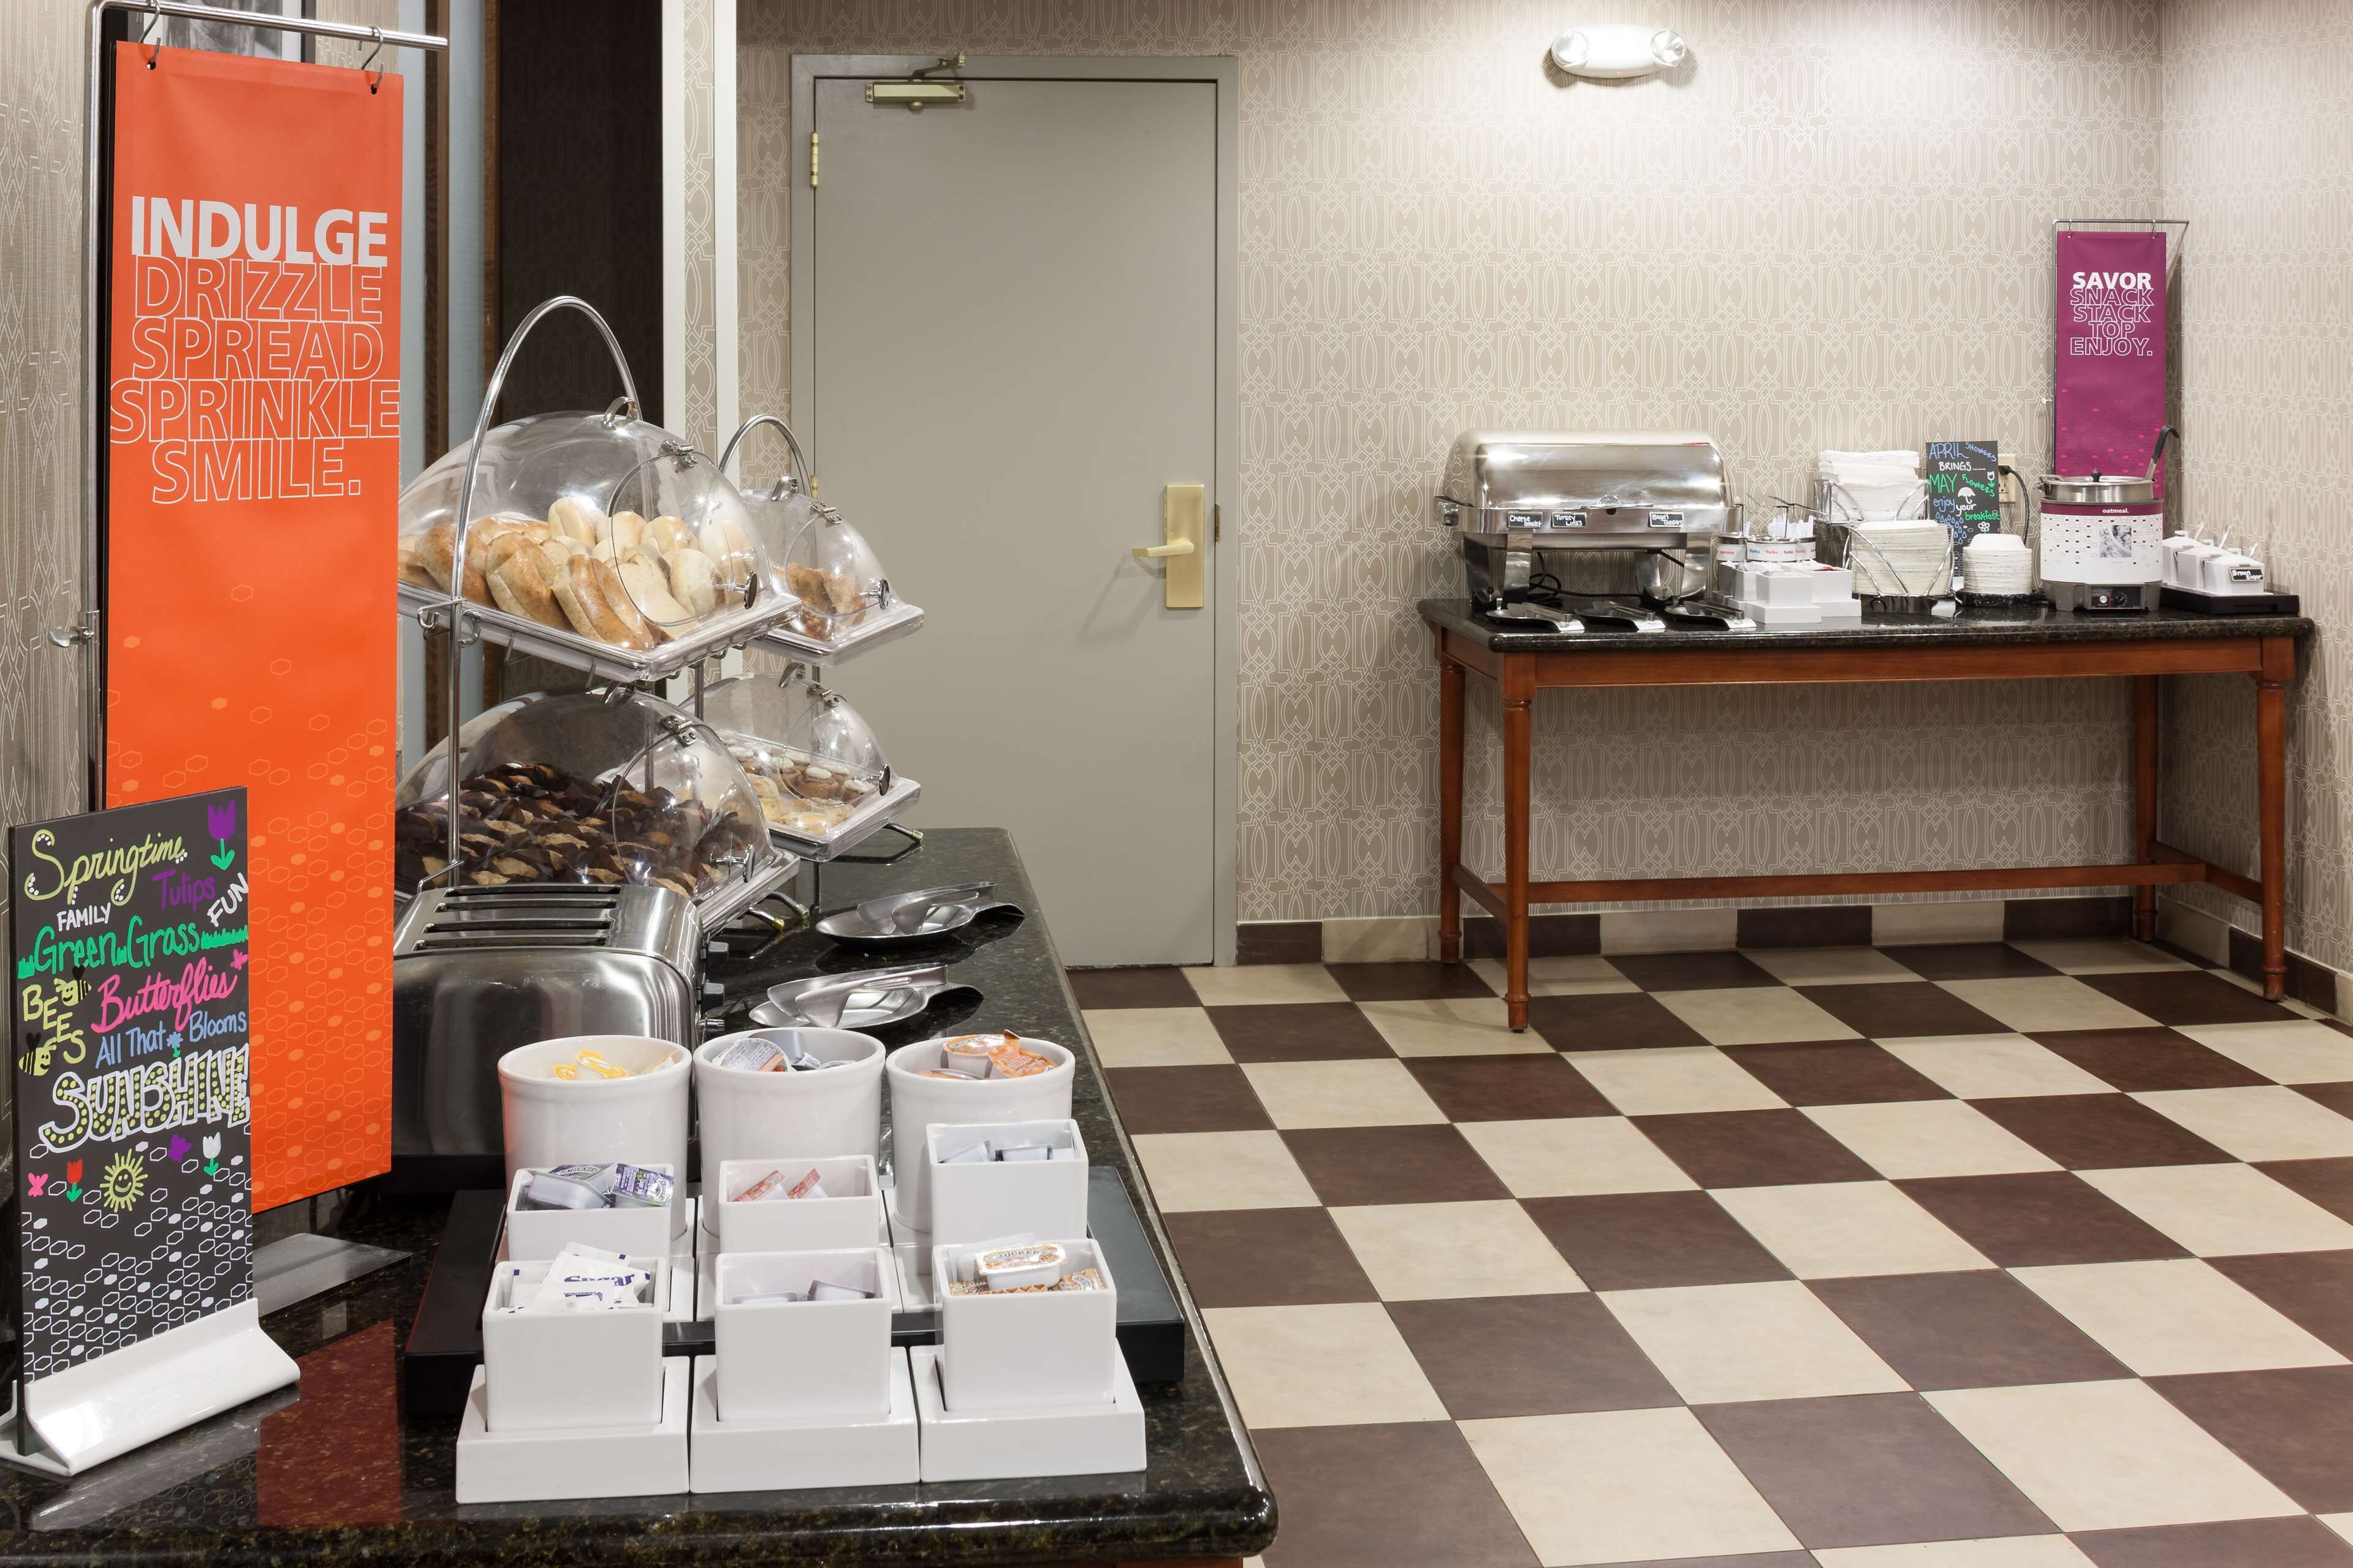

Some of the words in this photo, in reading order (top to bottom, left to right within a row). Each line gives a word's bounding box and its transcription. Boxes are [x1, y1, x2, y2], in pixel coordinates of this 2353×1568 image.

[132, 196, 387, 267] INDULGE
[135, 255, 382, 324] DRIZZLE
[2070, 288, 2154, 306] SNACK
[2072, 271, 2152, 290] SAVOR
[2073, 304, 2151, 322] STACK
[2088, 320, 2135, 339] TOP
[132, 317, 384, 381] SPREAD
[2070, 337, 2153, 356] ENJOY.
[110, 378, 400, 444] SPRINKLE
[152, 439, 361, 504] SMILE.
[1929, 442, 1969, 460] APRIL
[1964, 441, 1997, 462] SHOWERS
[1929, 473, 1958, 494] MAY
[1961, 474, 1996, 497] FLOWERS
[1933, 496, 1956, 513] enjoy
[1956, 503, 1977, 517] your
[1965, 510, 2001, 520] breakfast
[25, 828, 188, 906] Springtime
[152, 869, 216, 911] Tulips
[57, 902, 112, 932] FAMILY
[207, 873, 249, 927] FUN
[34, 925, 118, 974] Green
[126, 915, 200, 969] Grass
[91, 956, 238, 1033] Butterflies
[95, 1031, 122, 1069] All
[126, 1021, 167, 1059] That
[189, 1010, 248, 1043] Blooms
[38, 1043, 250, 1149] SUNSHINE
